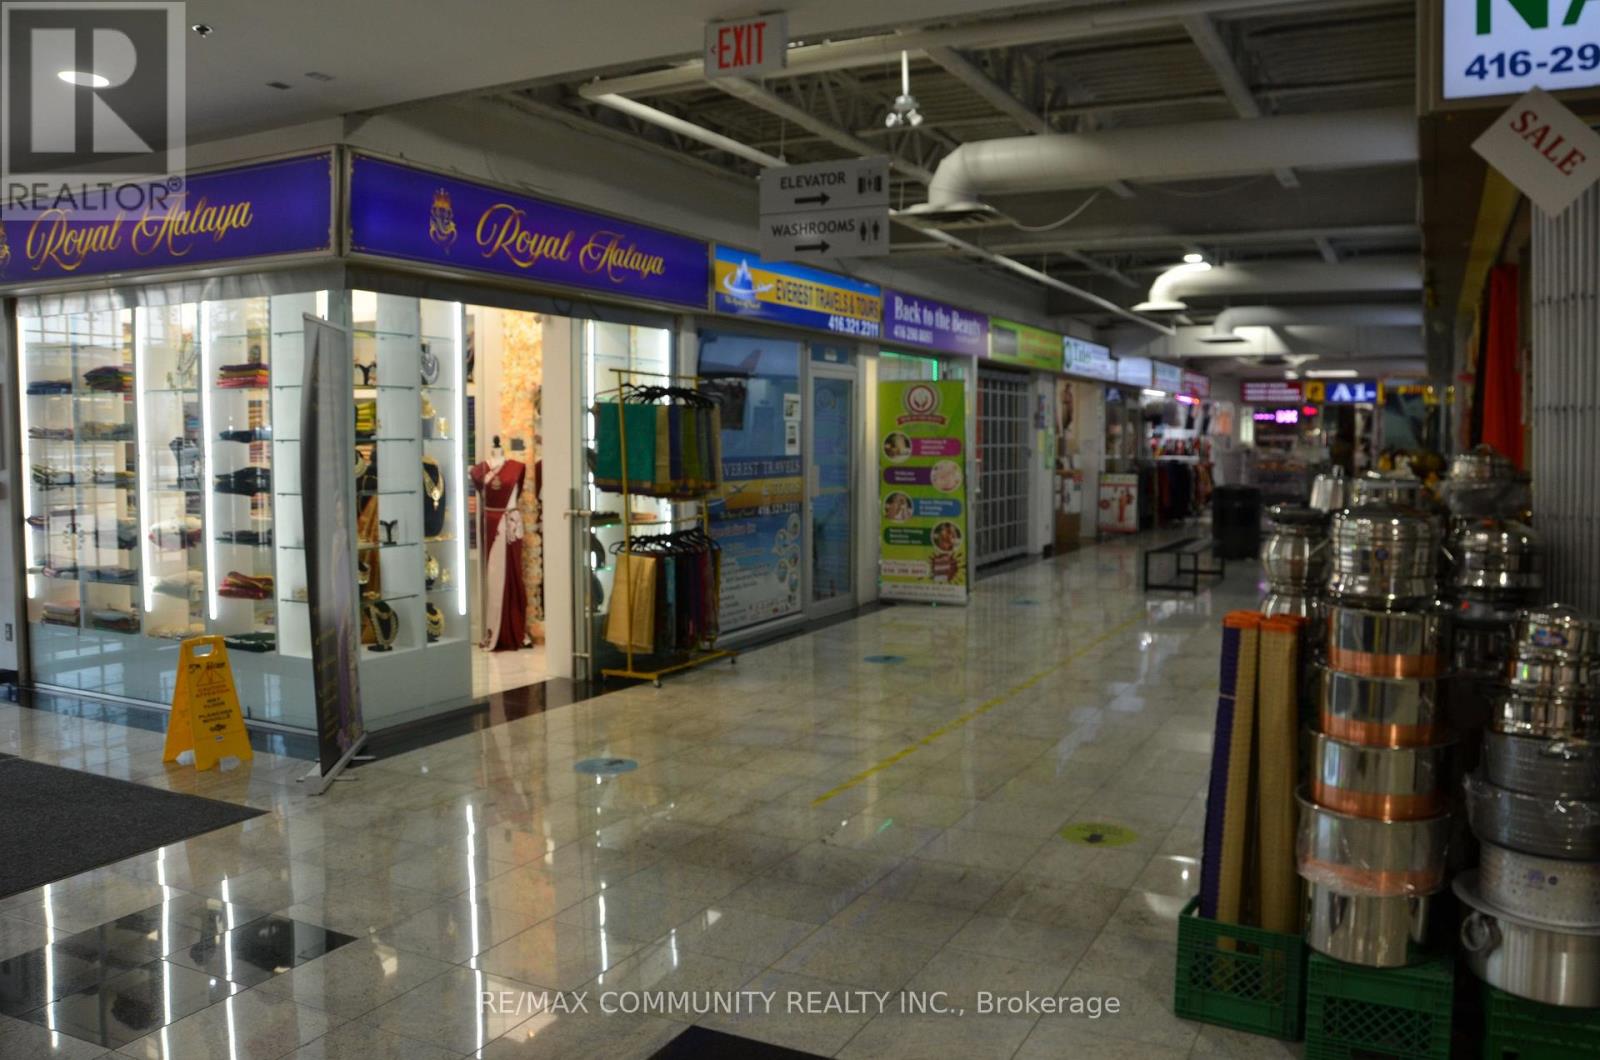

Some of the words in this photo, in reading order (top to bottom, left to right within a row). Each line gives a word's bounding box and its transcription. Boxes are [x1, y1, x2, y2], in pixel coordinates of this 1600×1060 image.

[718, 22, 767, 69] EXIT
[1509, 110, 1587, 176] SALE
[780, 171, 846, 190] ELEVATOR
[26, 208, 123, 271] Royal
[475, 203, 575, 268] Royal
[771, 219, 856, 237] WASHROOMS
[776, 278, 814, 306] EVEREST
[894, 296, 921, 324] Back
[922, 305, 934, 327] to
[935, 307, 951, 331] the
[722, 463, 760, 478] VEREST
